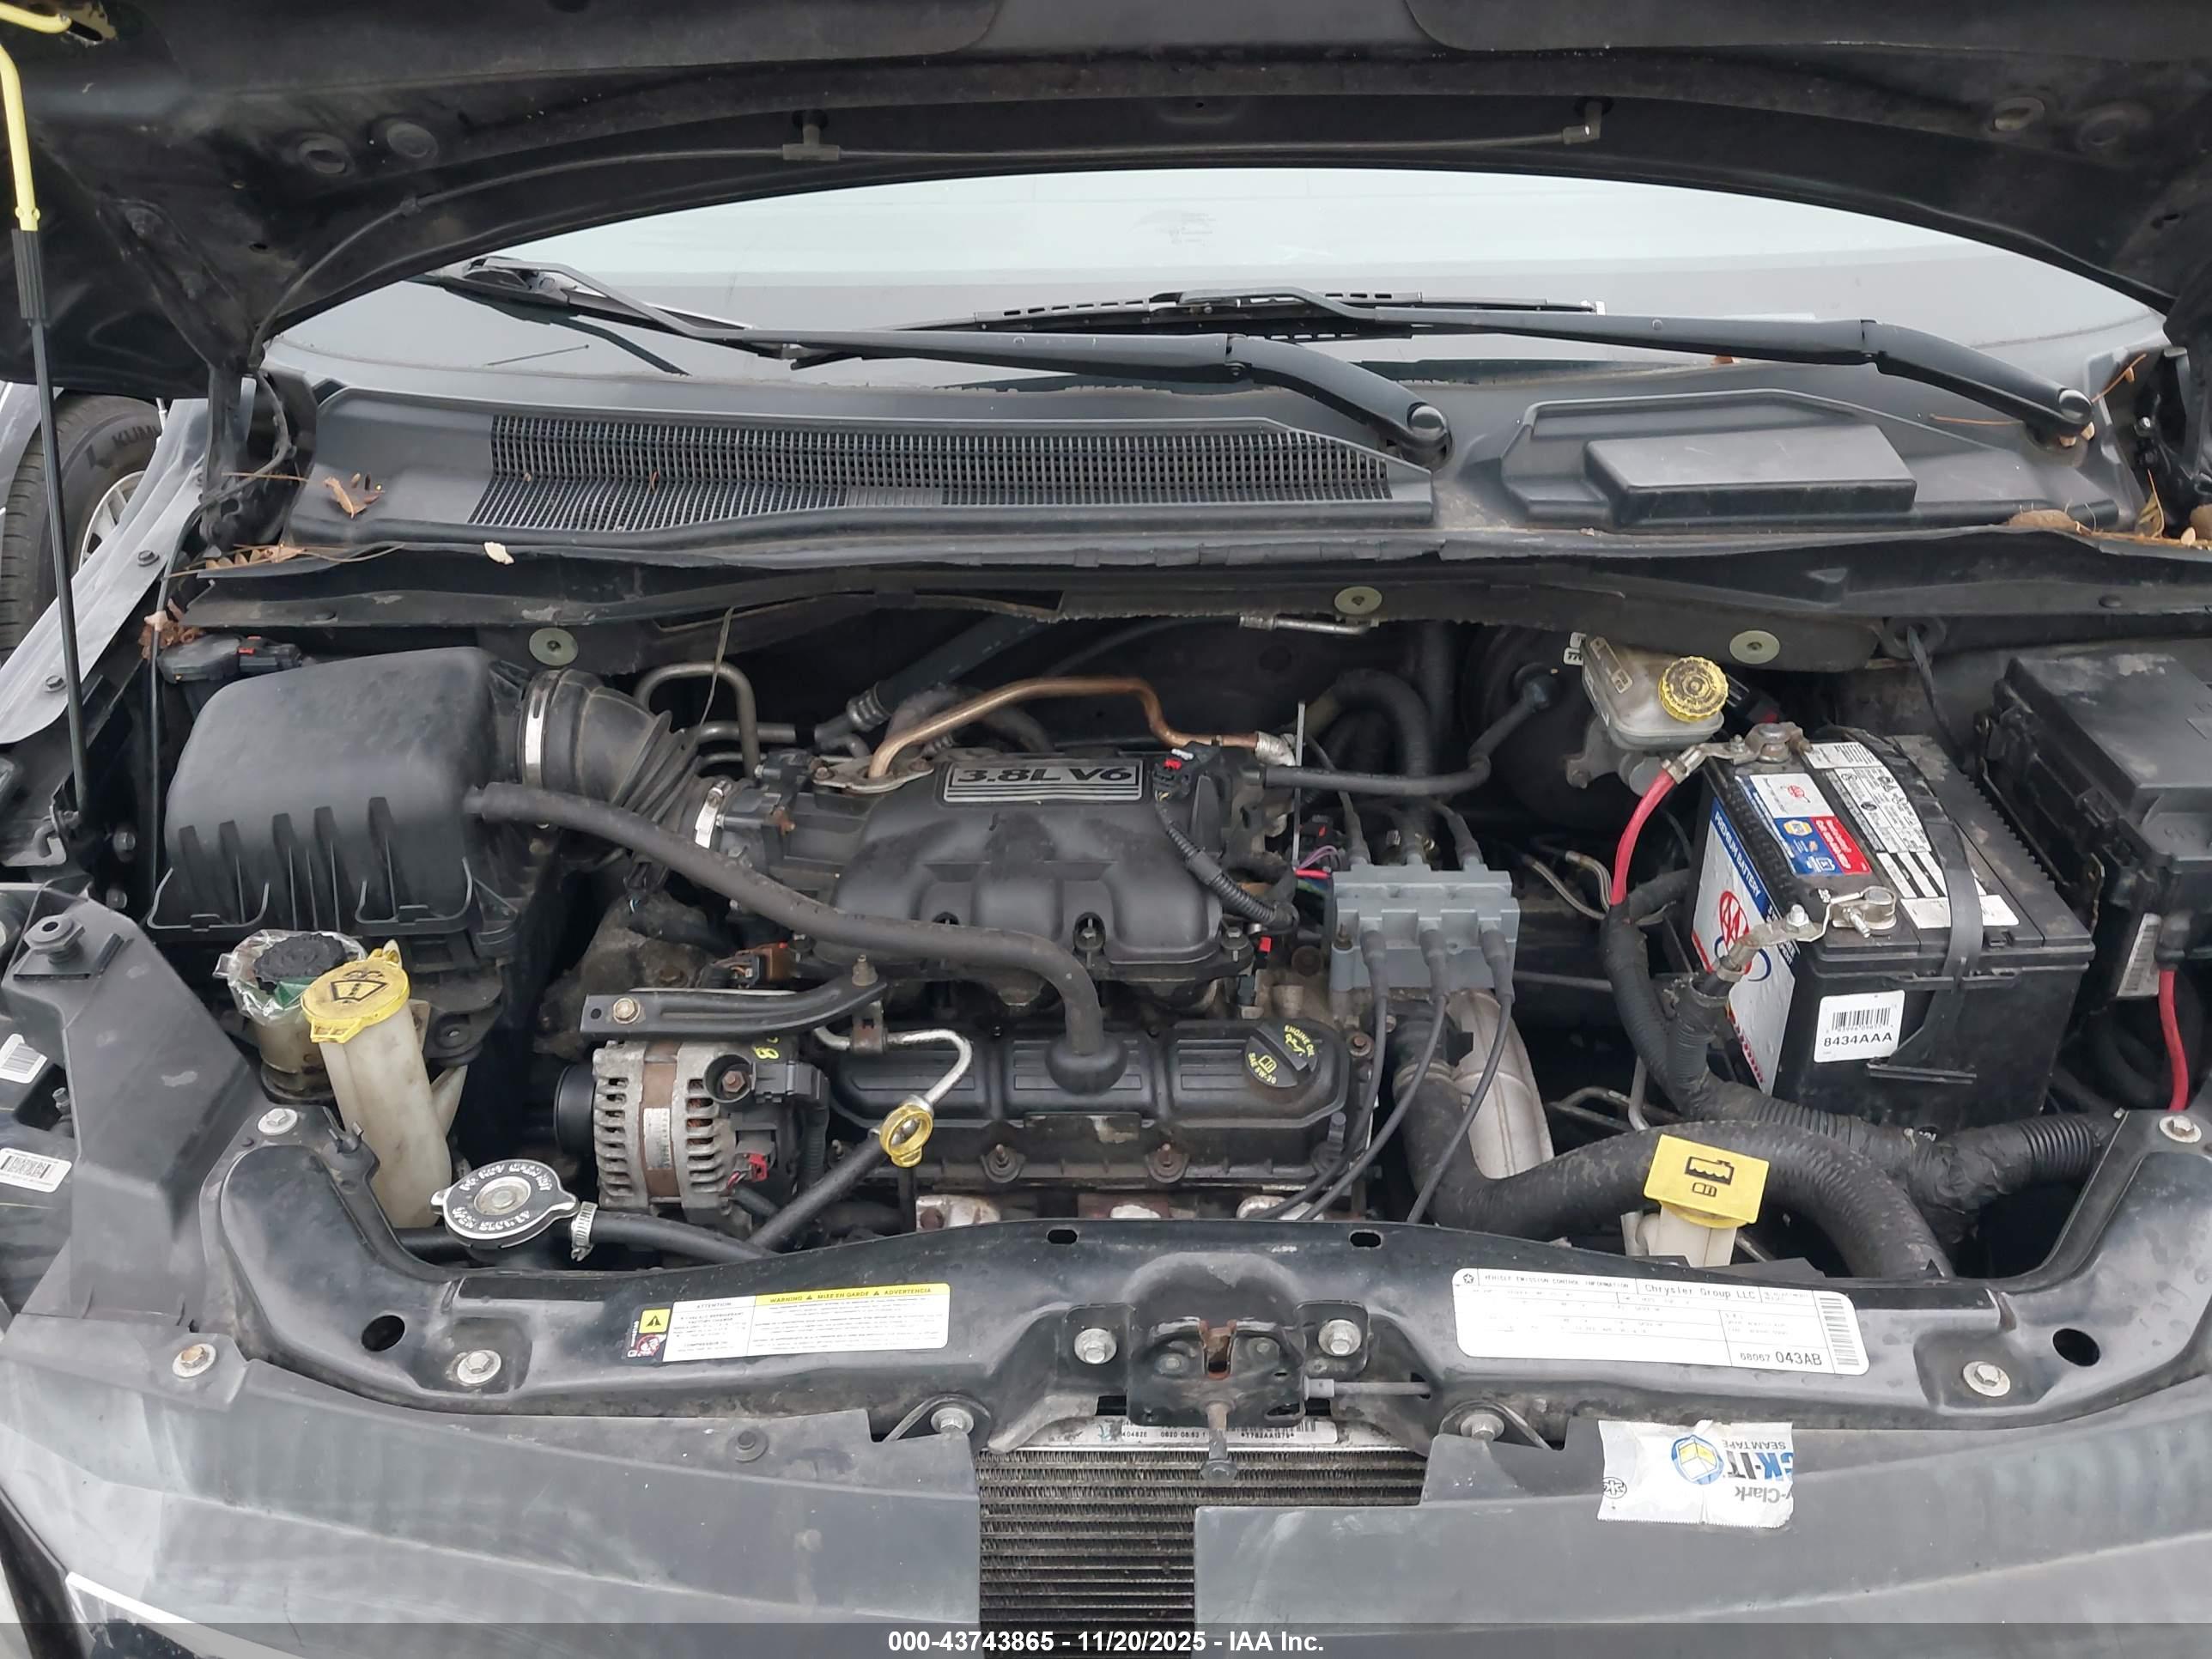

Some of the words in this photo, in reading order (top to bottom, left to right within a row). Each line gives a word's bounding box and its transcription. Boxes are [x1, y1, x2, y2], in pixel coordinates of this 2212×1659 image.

[957, 769, 1060, 782] 3.8L
[1068, 768, 1133, 782] V6
[1714, 810, 1740, 858] PREMIUM
[1735, 853, 1761, 898] BATTERY
[1285, 1024, 1310, 1045] ENGINE
[1306, 1044, 1315, 1058] OIL
[1824, 1032, 1893, 1047] 8434AAA
[1248, 1052, 1260, 1068] SAE
[1584, 1280, 1630, 1289] INFORMATION
[1645, 1284, 1692, 1297] Chrysler
[1700, 1287, 1731, 1298] Group
[1737, 1291, 1756, 1300] LLC
[770, 1295, 804, 1304] WARNING
[1775, 1351, 1823, 1366] 043AB
